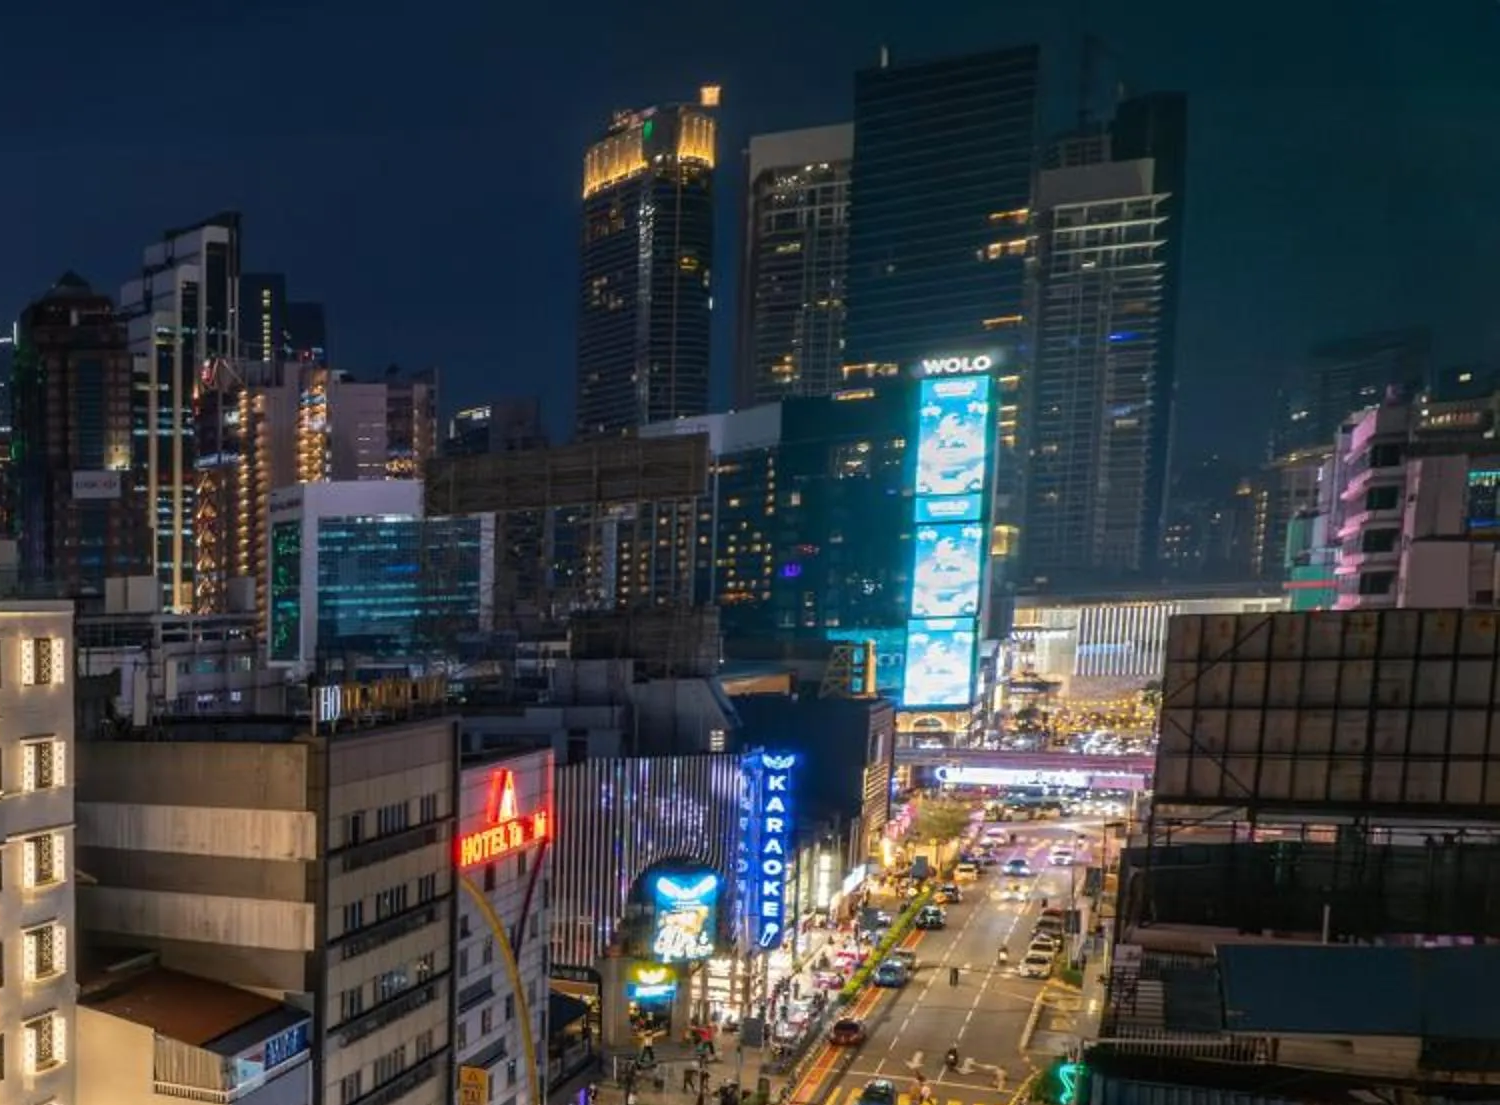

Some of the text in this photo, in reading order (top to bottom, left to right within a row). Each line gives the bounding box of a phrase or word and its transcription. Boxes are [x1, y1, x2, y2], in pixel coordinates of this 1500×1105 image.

[922, 355, 992, 375] WOLO
[461, 826, 509, 868] HOTEL
[761, 774, 787, 918] KARAOKE
